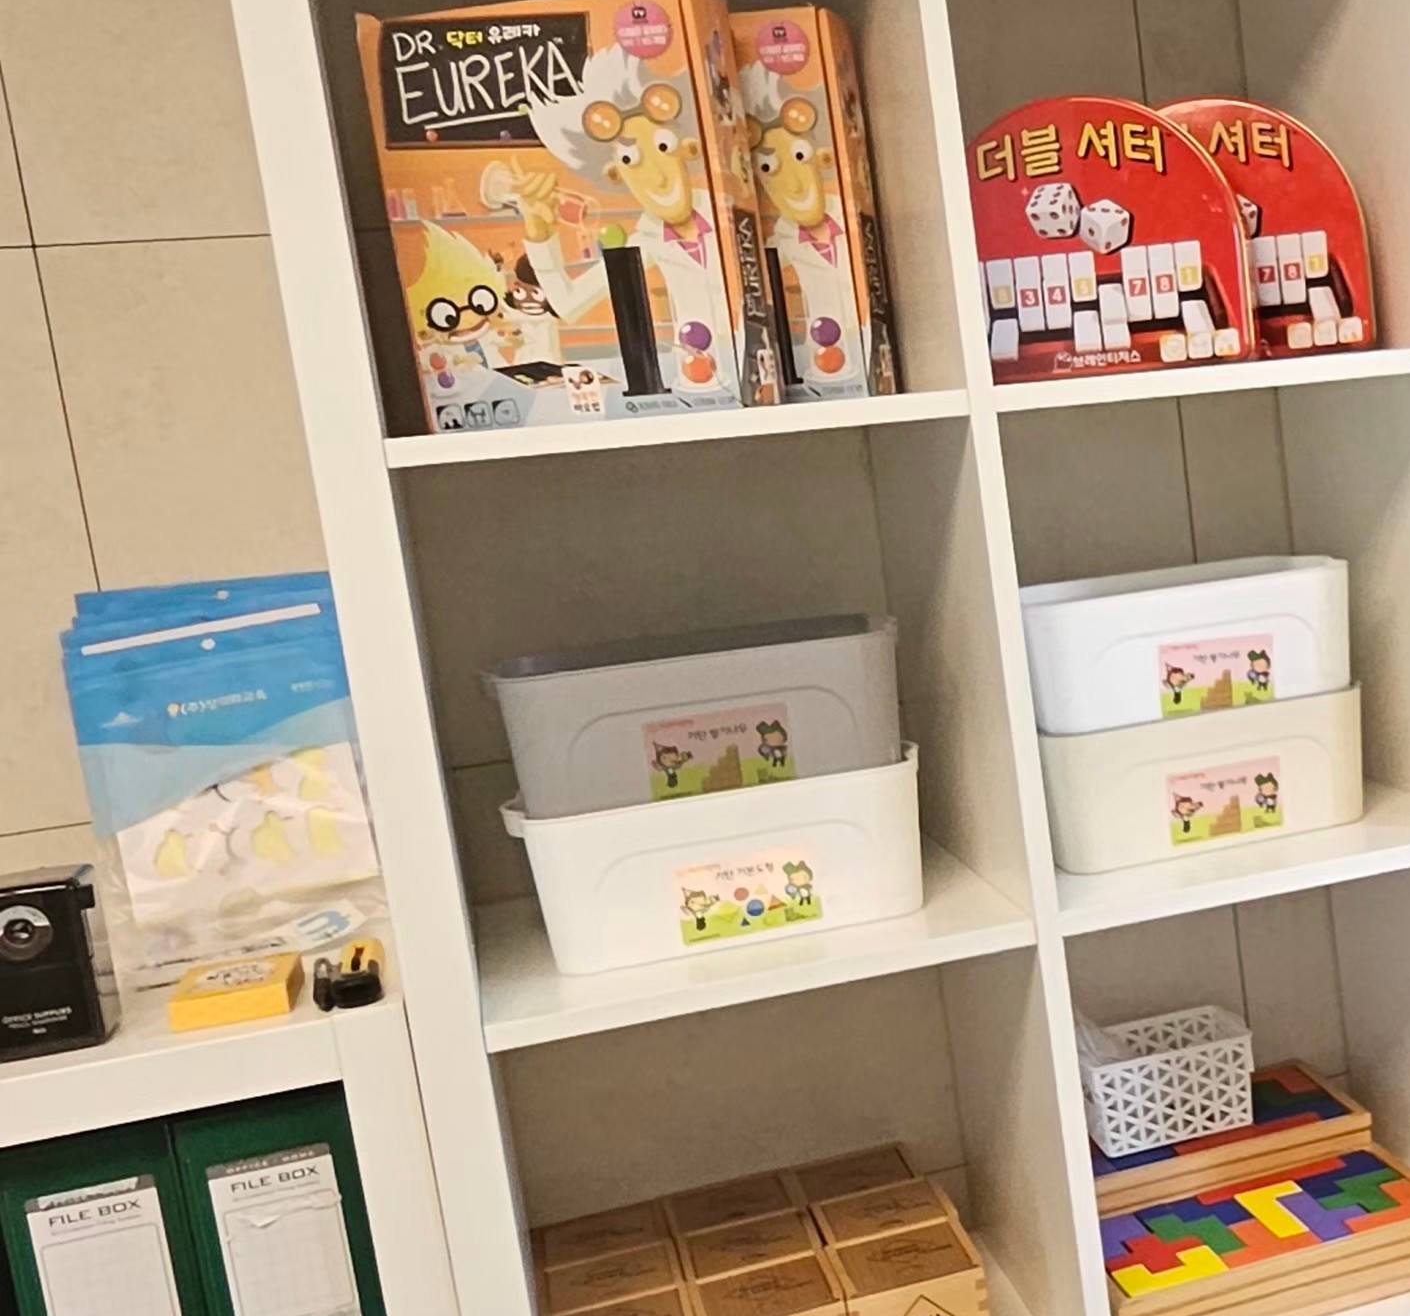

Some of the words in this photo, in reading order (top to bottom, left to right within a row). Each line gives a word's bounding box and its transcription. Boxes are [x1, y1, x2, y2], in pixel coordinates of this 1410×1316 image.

[446, 30, 483, 49] 닥터
[487, 23, 541, 45] 유레카
[395, 40, 583, 125] EUREKA
[975, 123, 1062, 182] 더블
[1077, 120, 1166, 174] 셔터
[1209, 119, 1292, 169] 셔터
[1262, 267, 1272, 281] 7
[1287, 265, 1298, 278] 8
[1025, 290, 1037, 305] 3
[1052, 287, 1063, 302] 4
[1132, 280, 1143, 295] 7
[1160, 275, 1169, 291] 8
[230, 1176, 272, 1194] FILE
[278, 1164, 320, 1182] BOX
[48, 1209, 91, 1227] FILE
[99, 1198, 142, 1216] BOX
